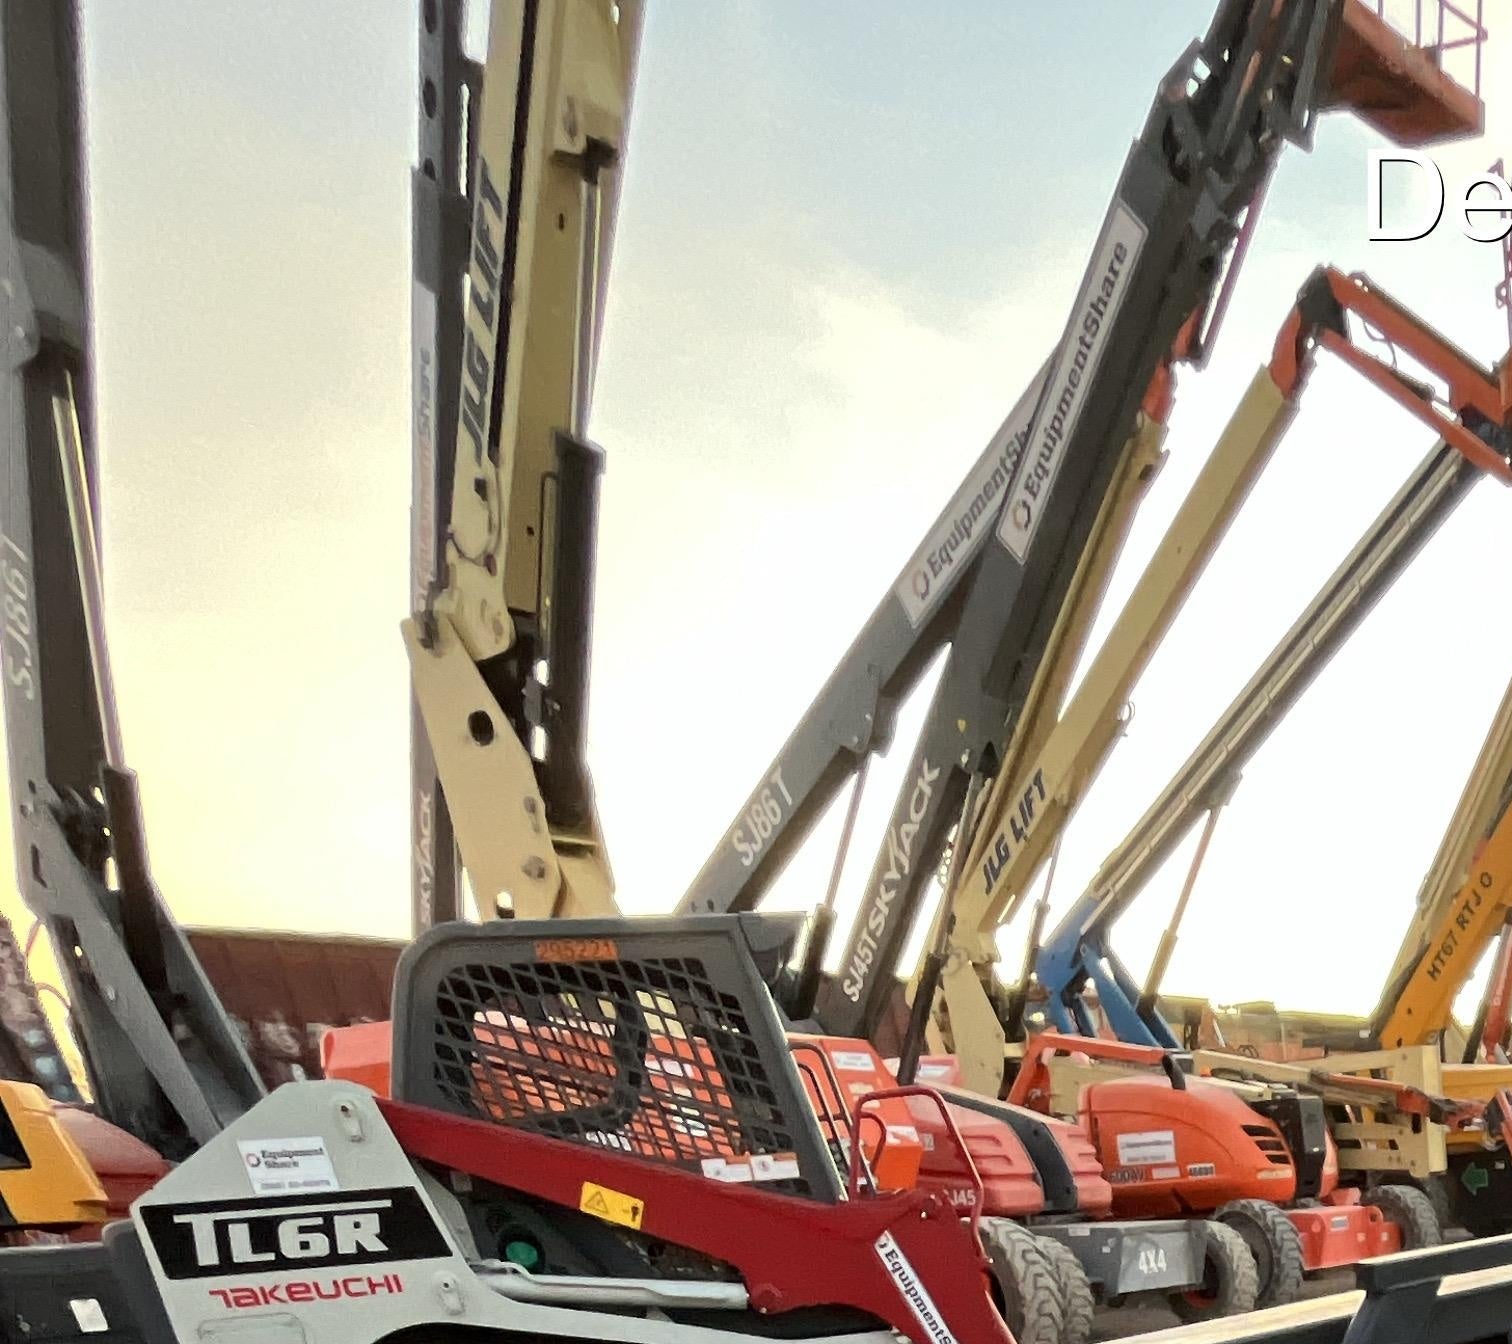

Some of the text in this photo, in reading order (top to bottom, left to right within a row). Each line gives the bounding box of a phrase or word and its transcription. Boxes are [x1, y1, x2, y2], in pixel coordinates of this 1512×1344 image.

[461, 157, 503, 466] JLG LIFT
[1023, 241, 1129, 502] EquipmentShare
[926, 426, 1029, 580] EquipmentSh
[415, 791, 434, 924] SKYJACK
[868, 757, 941, 937] SKYJACK
[982, 767, 1047, 895] JLG LIFT
[173, 1199, 392, 1266] TL6R
